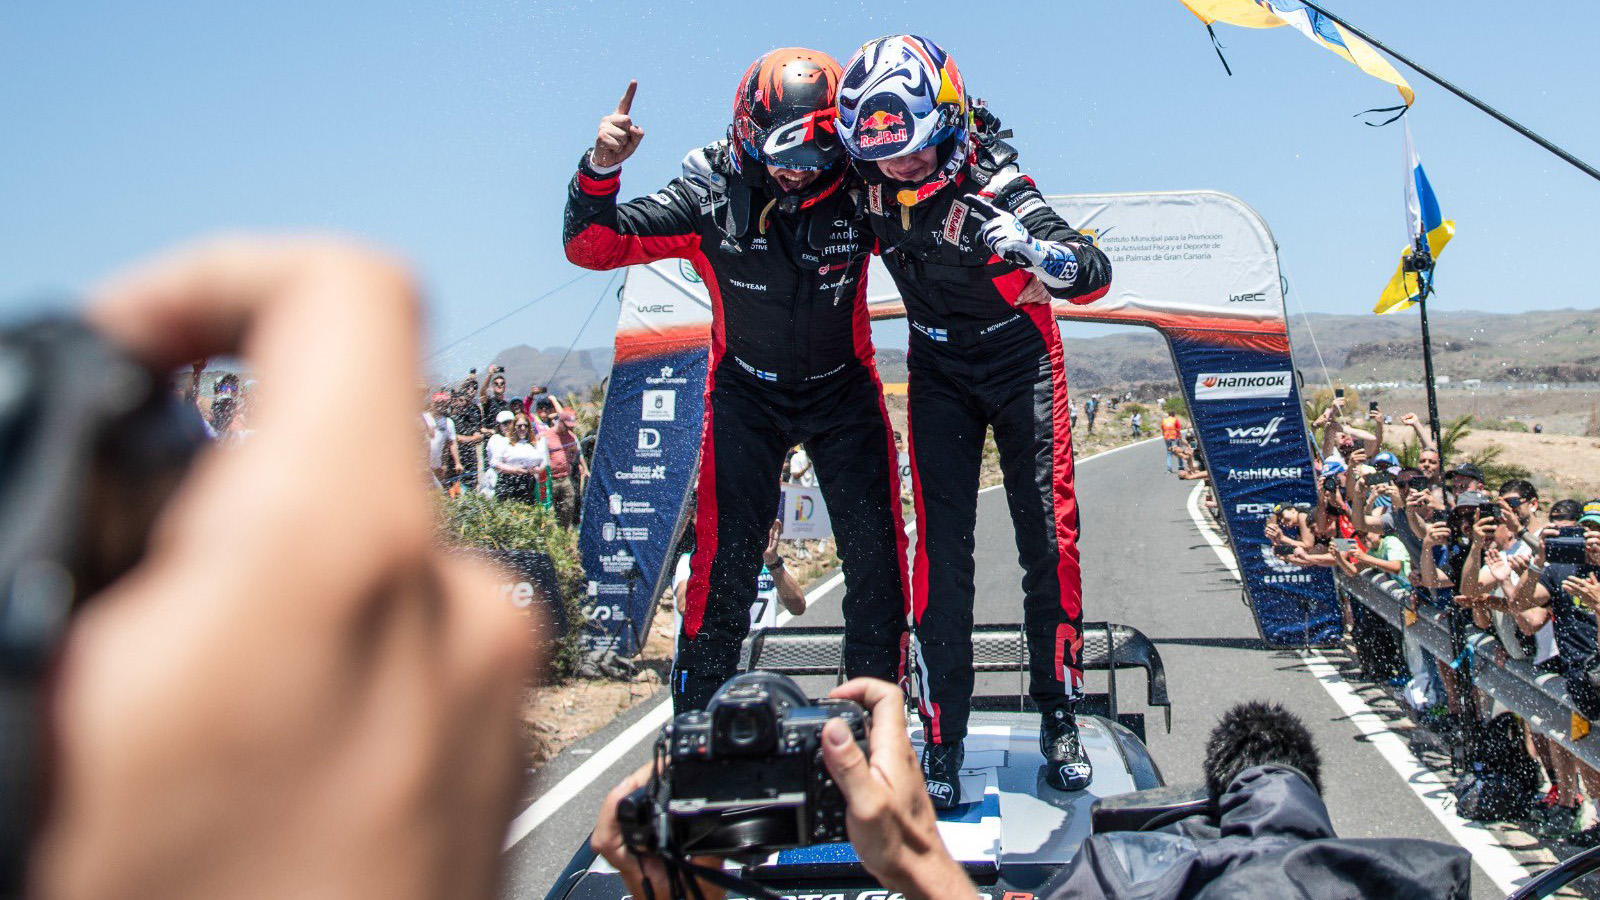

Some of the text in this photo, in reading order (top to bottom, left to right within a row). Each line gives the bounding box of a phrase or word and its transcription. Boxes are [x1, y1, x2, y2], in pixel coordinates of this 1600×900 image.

[860, 129, 908, 148] Red Bull
[948, 206, 964, 240] SIMPSON
[1131, 235, 1163, 243] Municipal
[1184, 242, 1211, 250] Deporte
[1126, 254, 1151, 262] Palmas
[1184, 252, 1212, 260] Canaria
[1229, 293, 1266, 302] WRC
[638, 304, 674, 313] WRC
[1225, 417, 1286, 447] wolf
[1263, 574, 1312, 584] CASTORE
